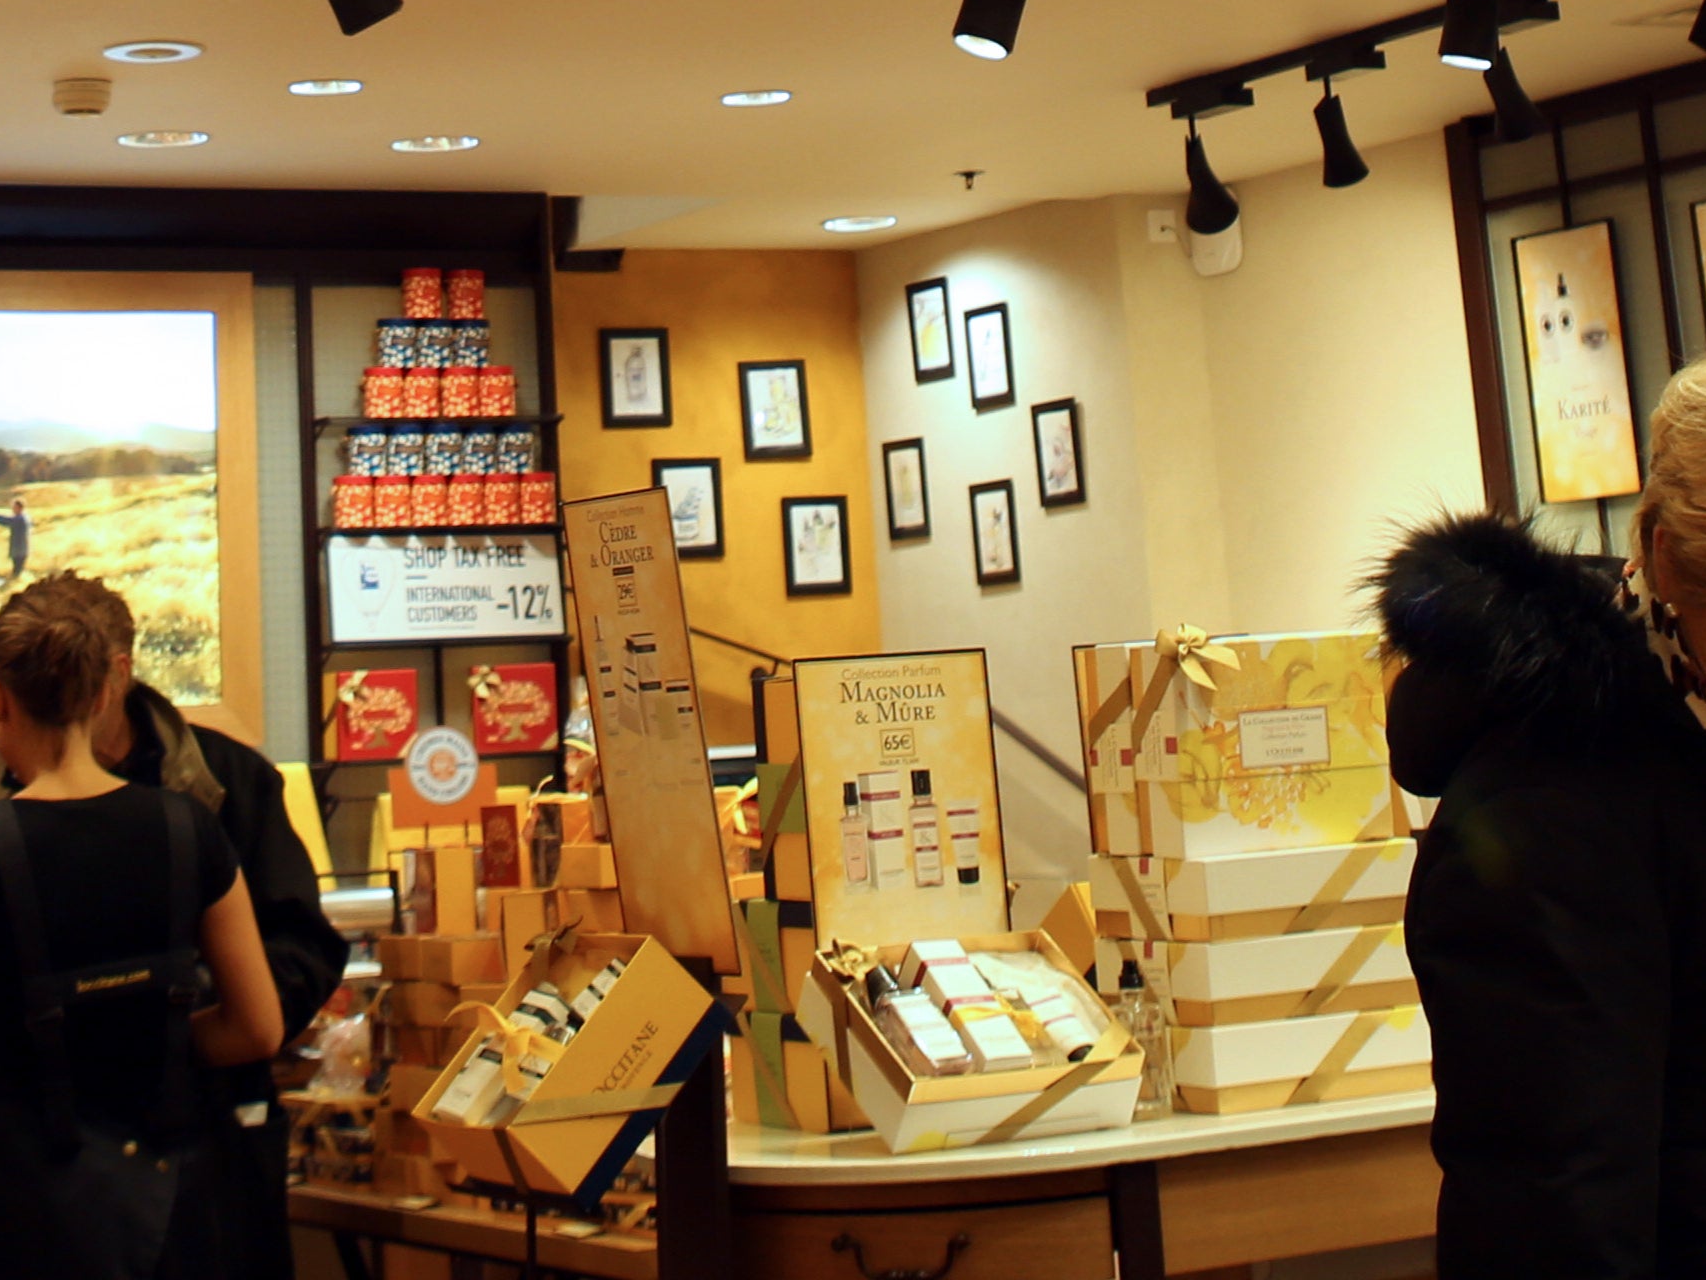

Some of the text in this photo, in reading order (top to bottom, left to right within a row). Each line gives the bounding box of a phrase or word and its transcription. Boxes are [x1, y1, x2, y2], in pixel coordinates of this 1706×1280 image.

[403, 544, 526, 569] SHOP TAX FREE
[406, 585, 554, 620] INTERNATIONAL -12%
[407, 605, 478, 623] CUSTOMERS
[841, 664, 941, 682] Collection Parfum
[839, 680, 946, 704] MAGNOLIA
[855, 701, 936, 725] & MÛRE
[884, 734, 913, 751] 65€
